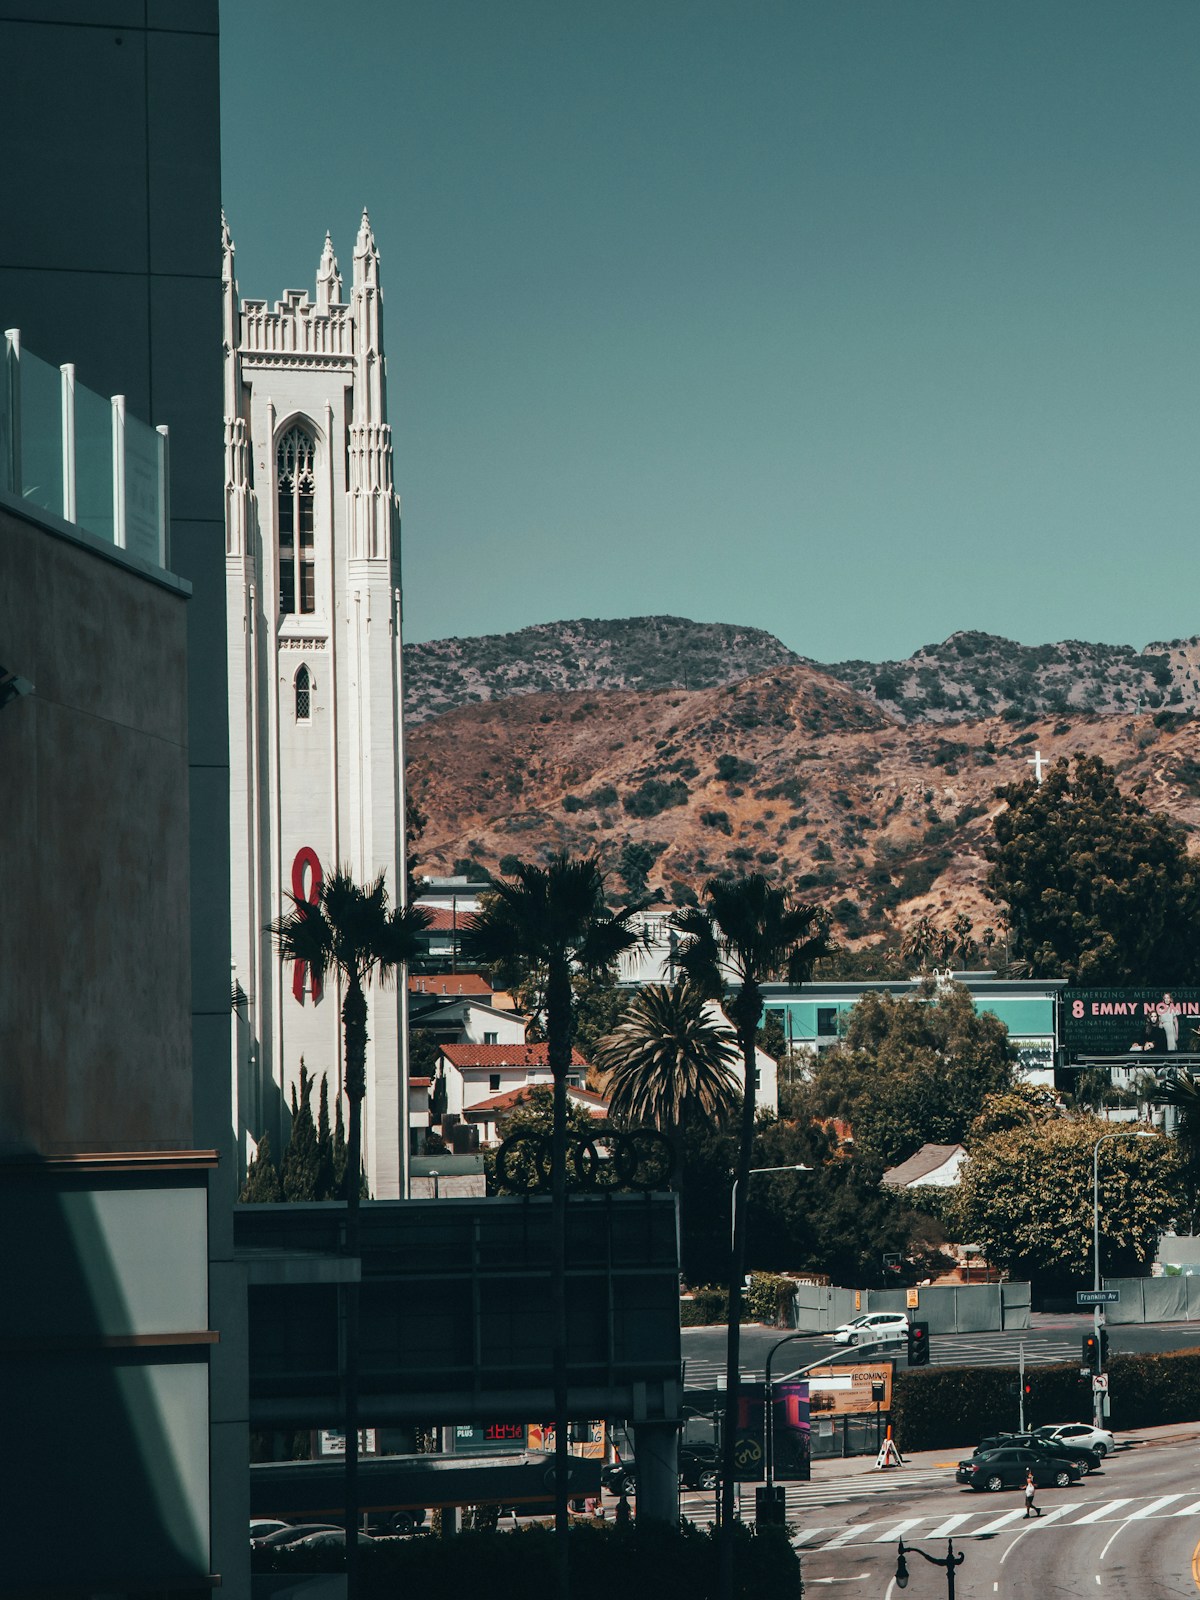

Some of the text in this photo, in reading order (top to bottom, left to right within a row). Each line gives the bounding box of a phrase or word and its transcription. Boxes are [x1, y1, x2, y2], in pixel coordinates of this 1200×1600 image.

[1064, 991, 1125, 999] MESMERIZING
[1072, 999, 1085, 1019] 8
[1092, 1002, 1138, 1016] EMMY
[1080, 1292, 1117, 1301] Franklin Av
[457, 1429, 473, 1438] PLUS
